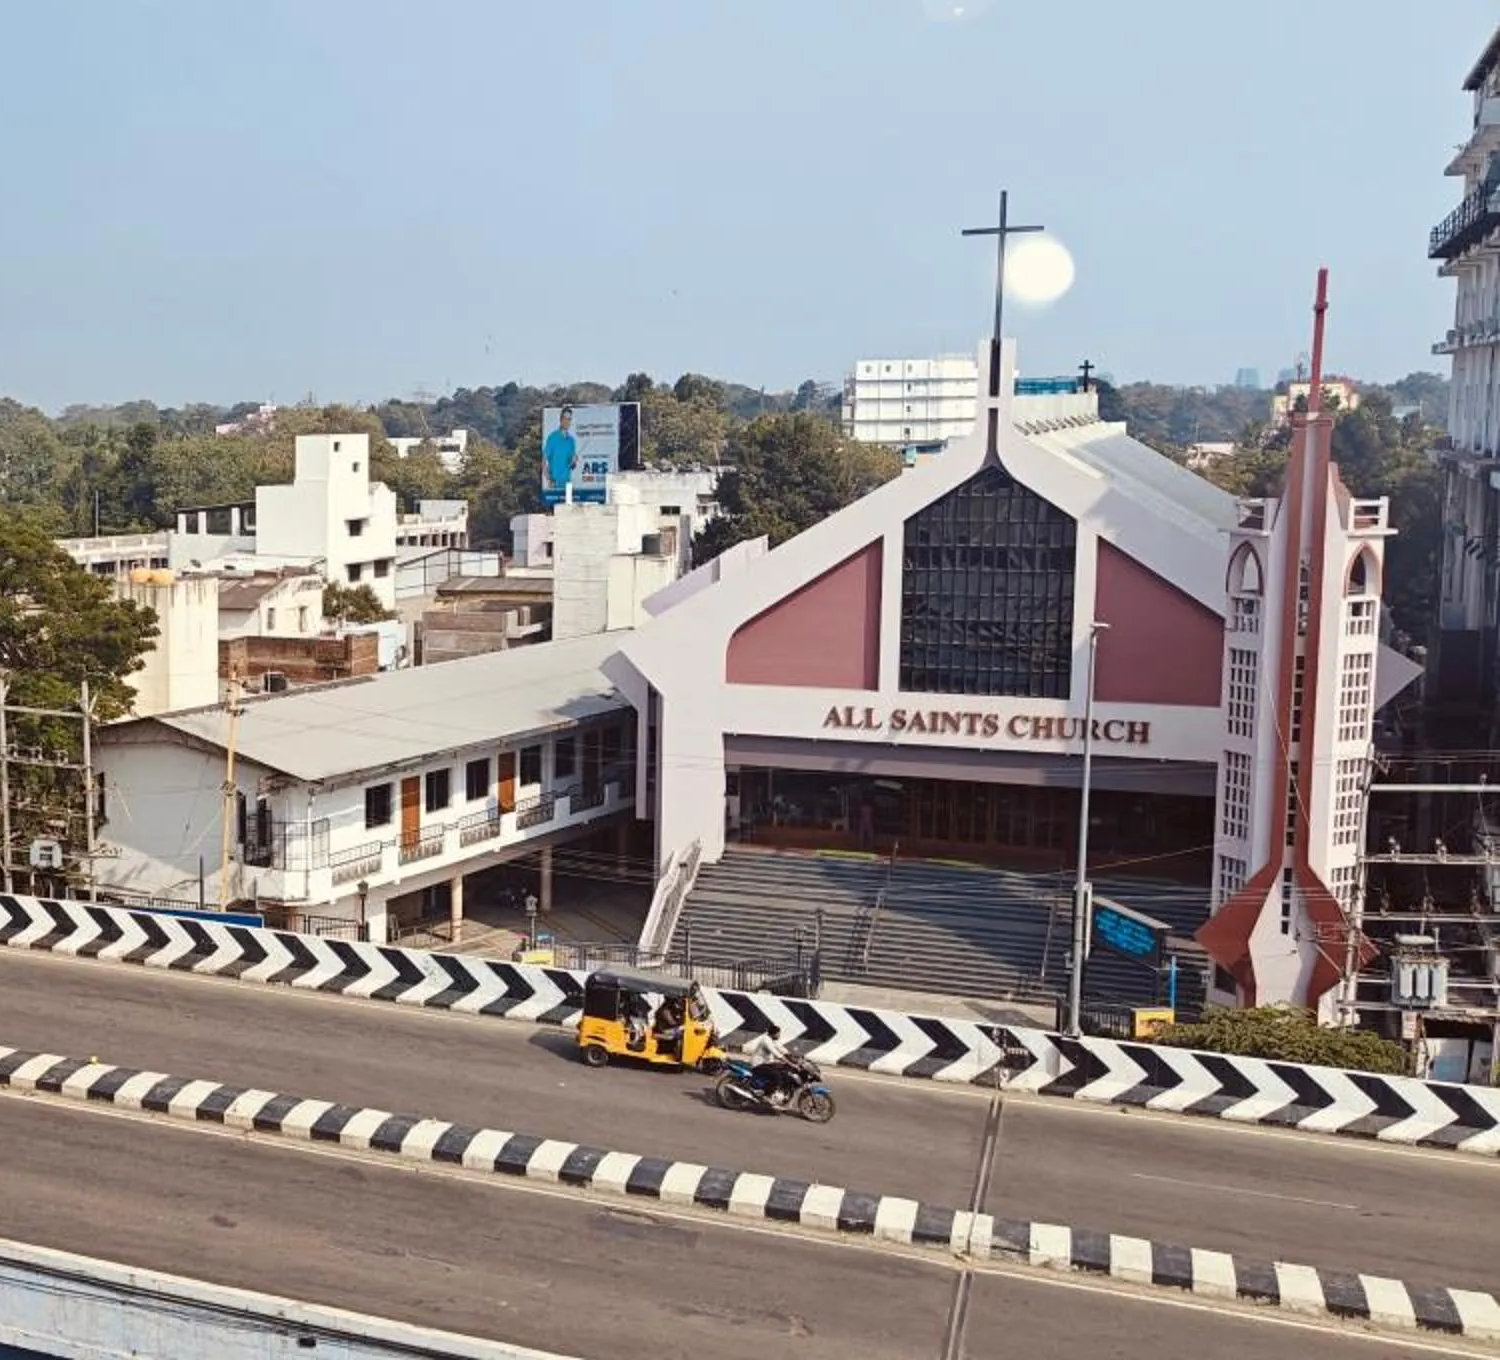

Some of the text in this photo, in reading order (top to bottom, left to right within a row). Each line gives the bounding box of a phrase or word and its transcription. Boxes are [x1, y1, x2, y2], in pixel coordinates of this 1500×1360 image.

[582, 461, 608, 474] ARS
[822, 705, 1152, 745] ALL SAINTS CHURCH
